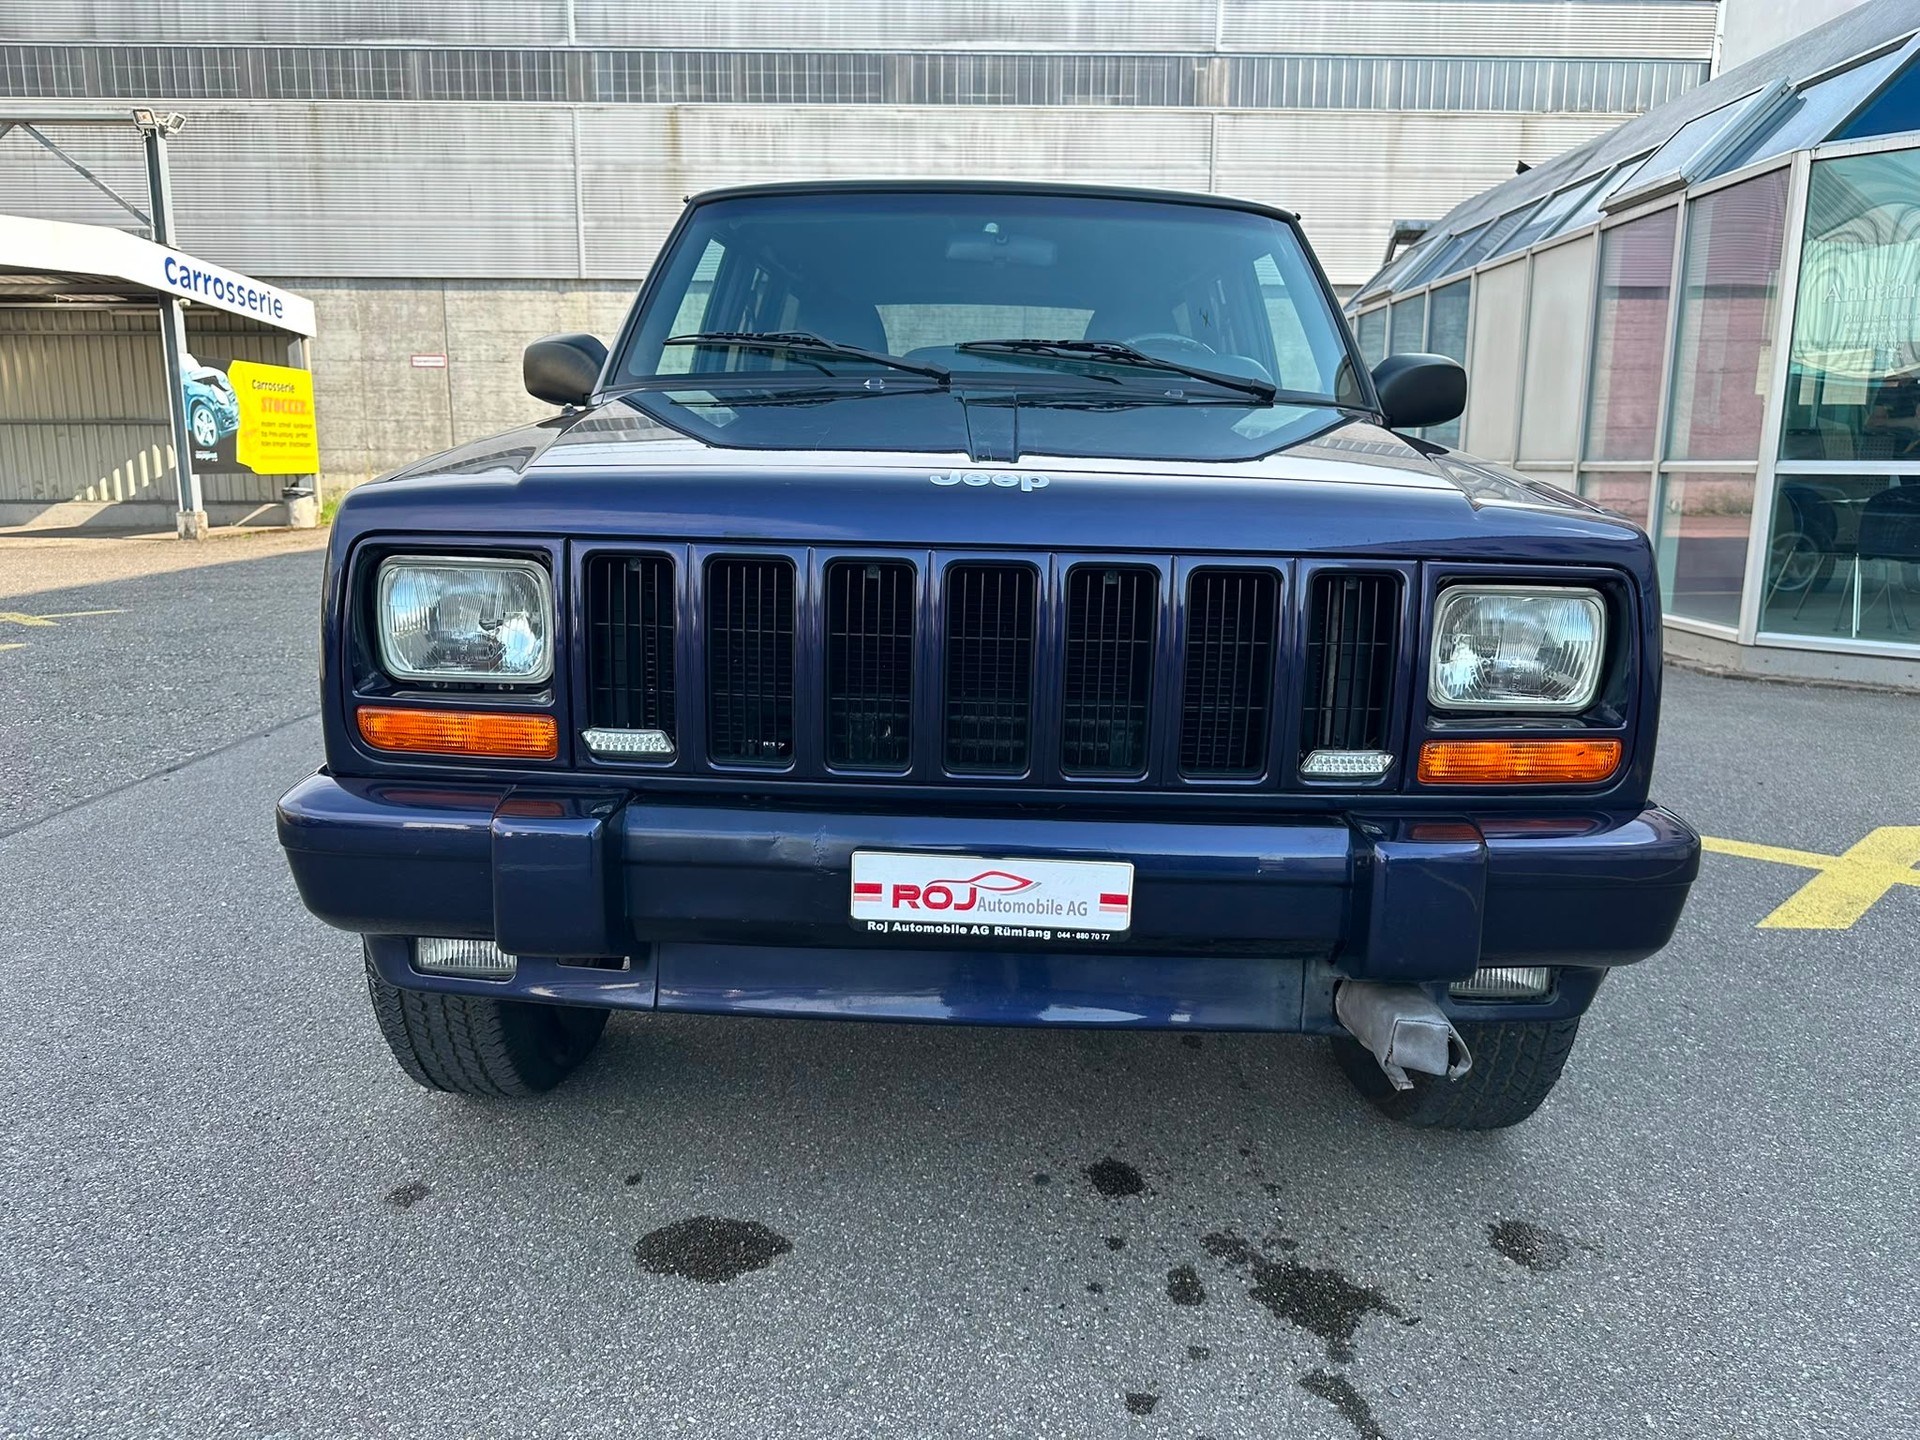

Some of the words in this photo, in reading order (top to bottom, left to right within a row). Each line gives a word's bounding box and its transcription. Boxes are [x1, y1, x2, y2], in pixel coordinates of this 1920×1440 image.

[164, 256, 284, 319] Carrosserie
[251, 379, 295, 393] Carrosserie
[929, 471, 1050, 492] Jeep
[892, 884, 977, 911] ROJ
[977, 897, 1063, 915] Automobile
[1066, 901, 1088, 917] AG
[867, 921, 889, 933] Roj
[892, 922, 968, 935] Automobile
[970, 925, 990, 935] AG
[994, 926, 1051, 939] Rümlang
